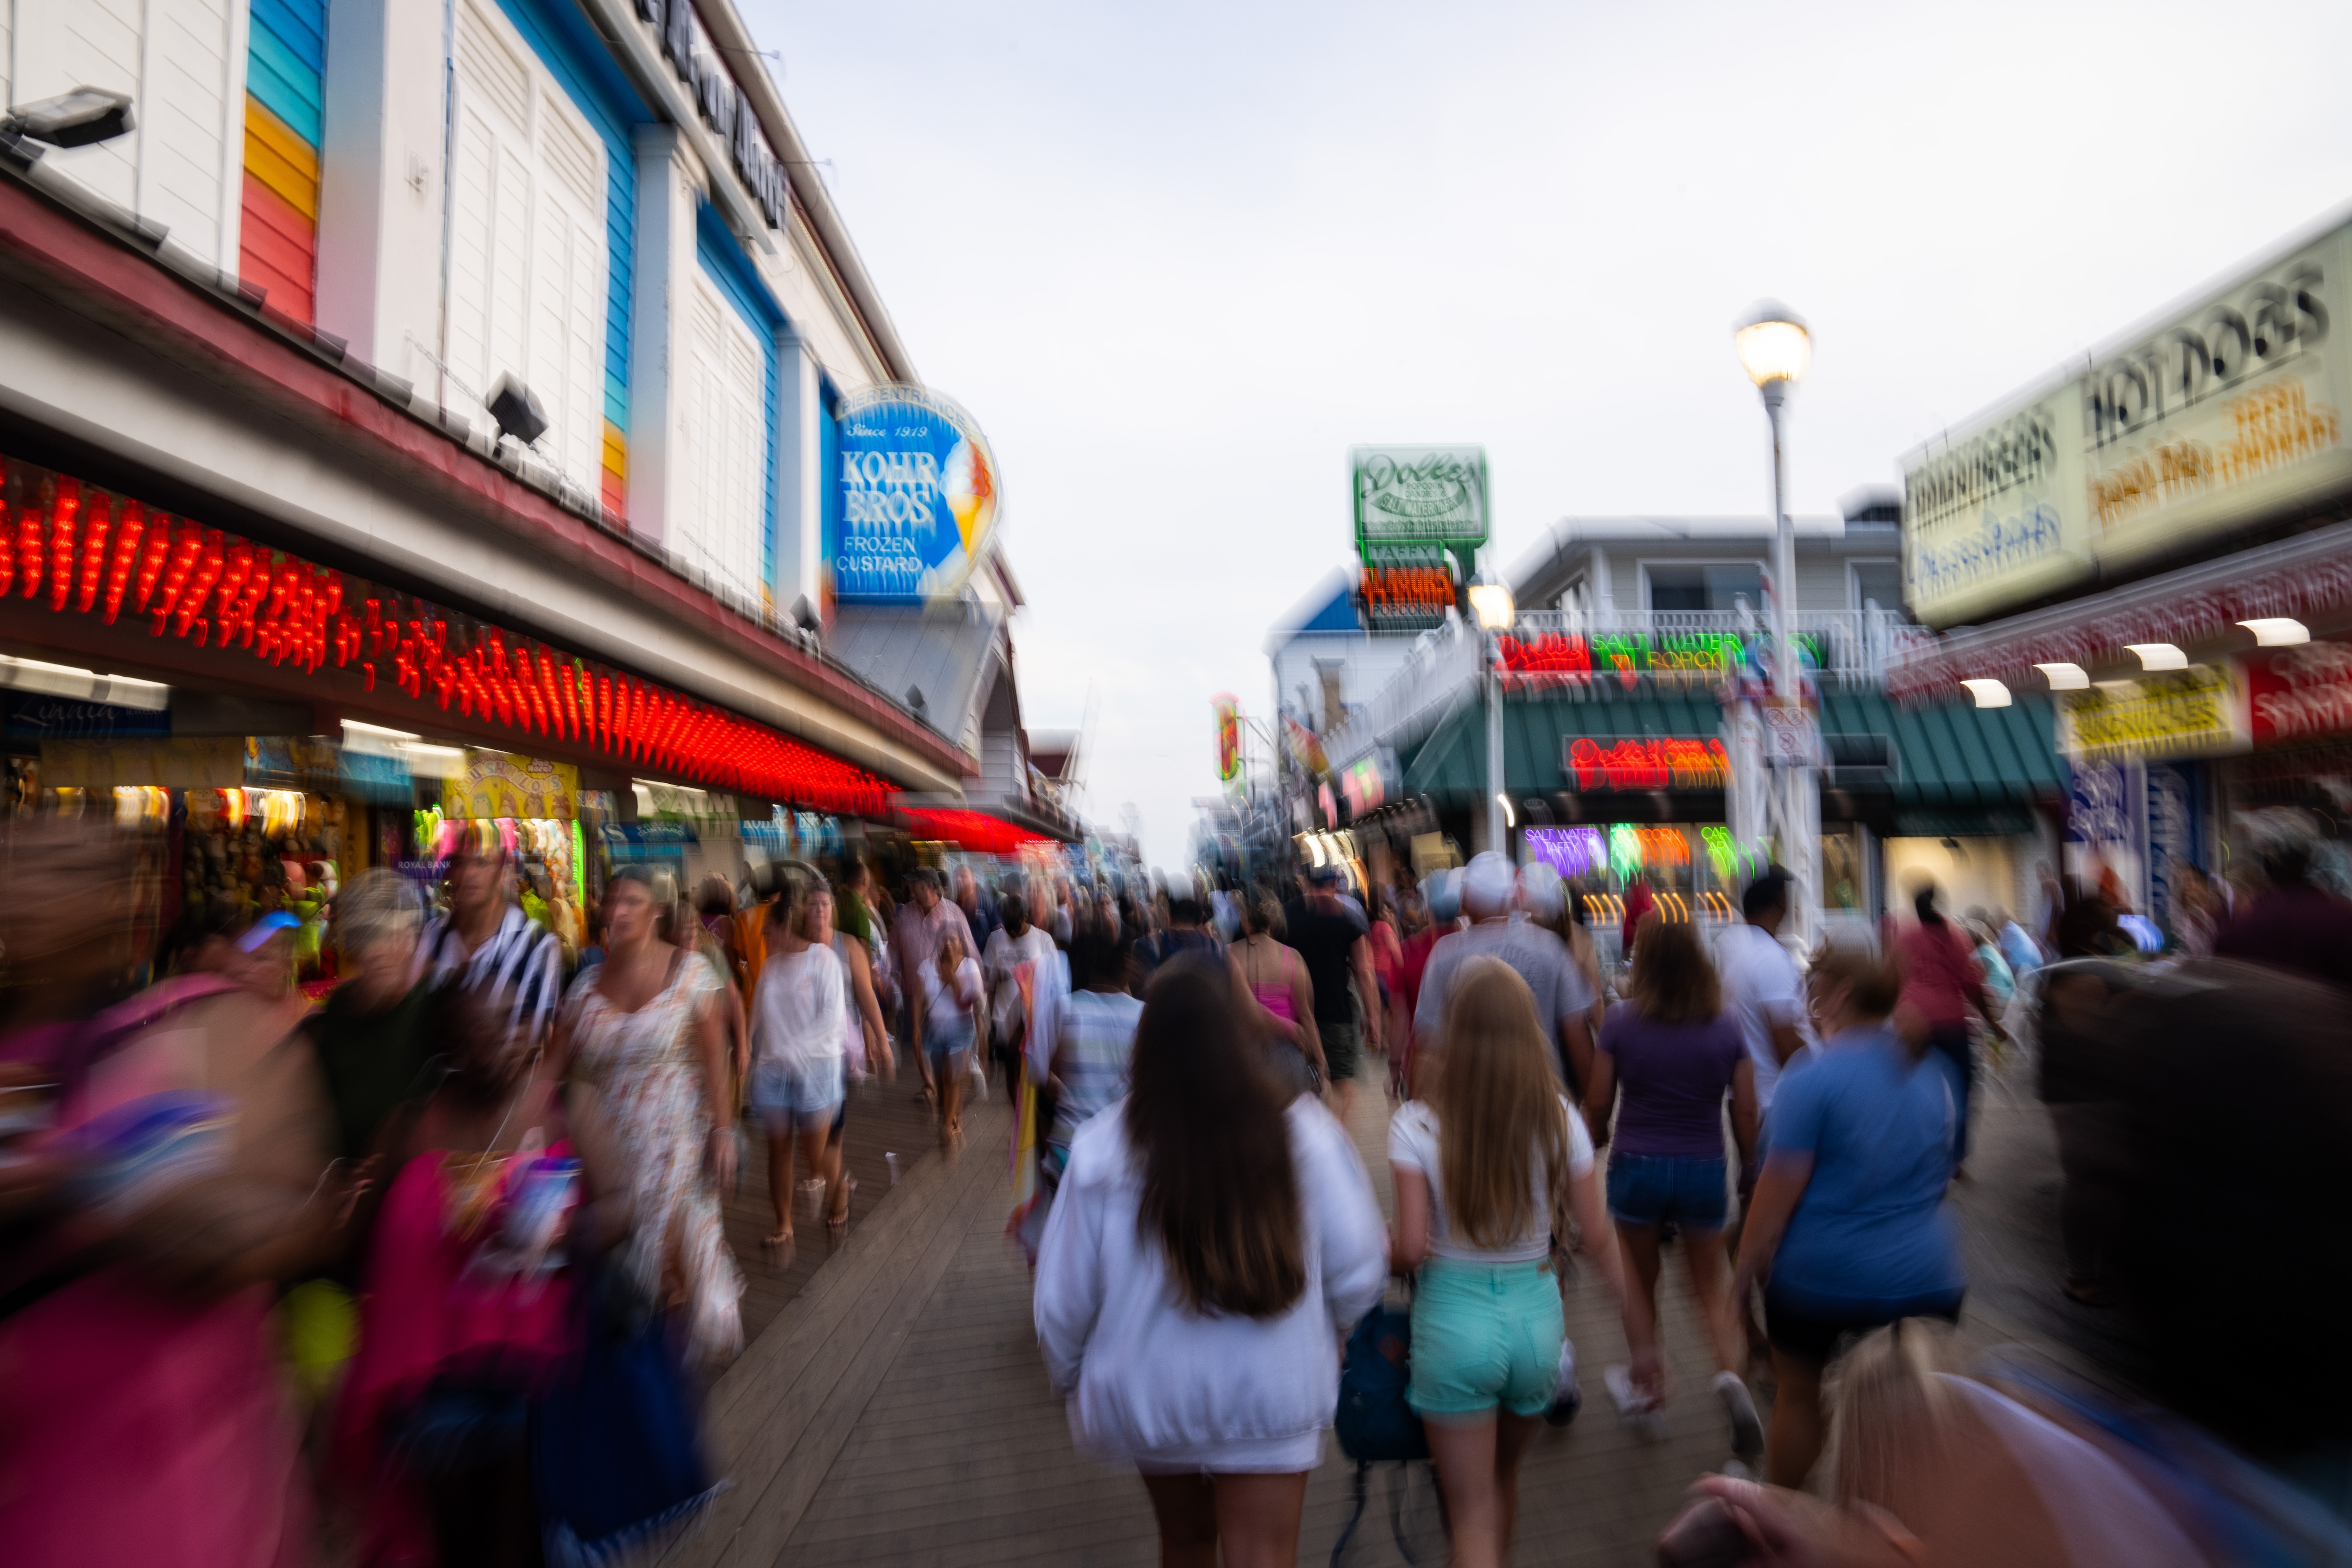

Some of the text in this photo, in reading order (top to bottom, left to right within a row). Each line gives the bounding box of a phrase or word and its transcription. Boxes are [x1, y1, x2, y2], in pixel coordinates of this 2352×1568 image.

[2082, 259, 2330, 429] HOT DOGS
[842, 387, 969, 431] PIER ENTRANCE
[847, 423, 928, 437] Since 1919
[840, 451, 936, 484] KOHR
[1361, 452, 1474, 498] Dolle's
[842, 490, 931, 523] BROS
[1381, 495, 1459, 516] SALT WATER TAFFY
[844, 537, 916, 553] FROZEN
[1373, 546, 1430, 558] TAFFY
[837, 556, 922, 572] CUSTARD
[466, 752, 505, 766] ORIGINAL
[453, 760, 563, 794] SQUISHMALLOWS
[670, 791, 735, 813] ATM
[636, 822, 684, 831] FROZEN
[637, 827, 684, 837] CUSTARD
